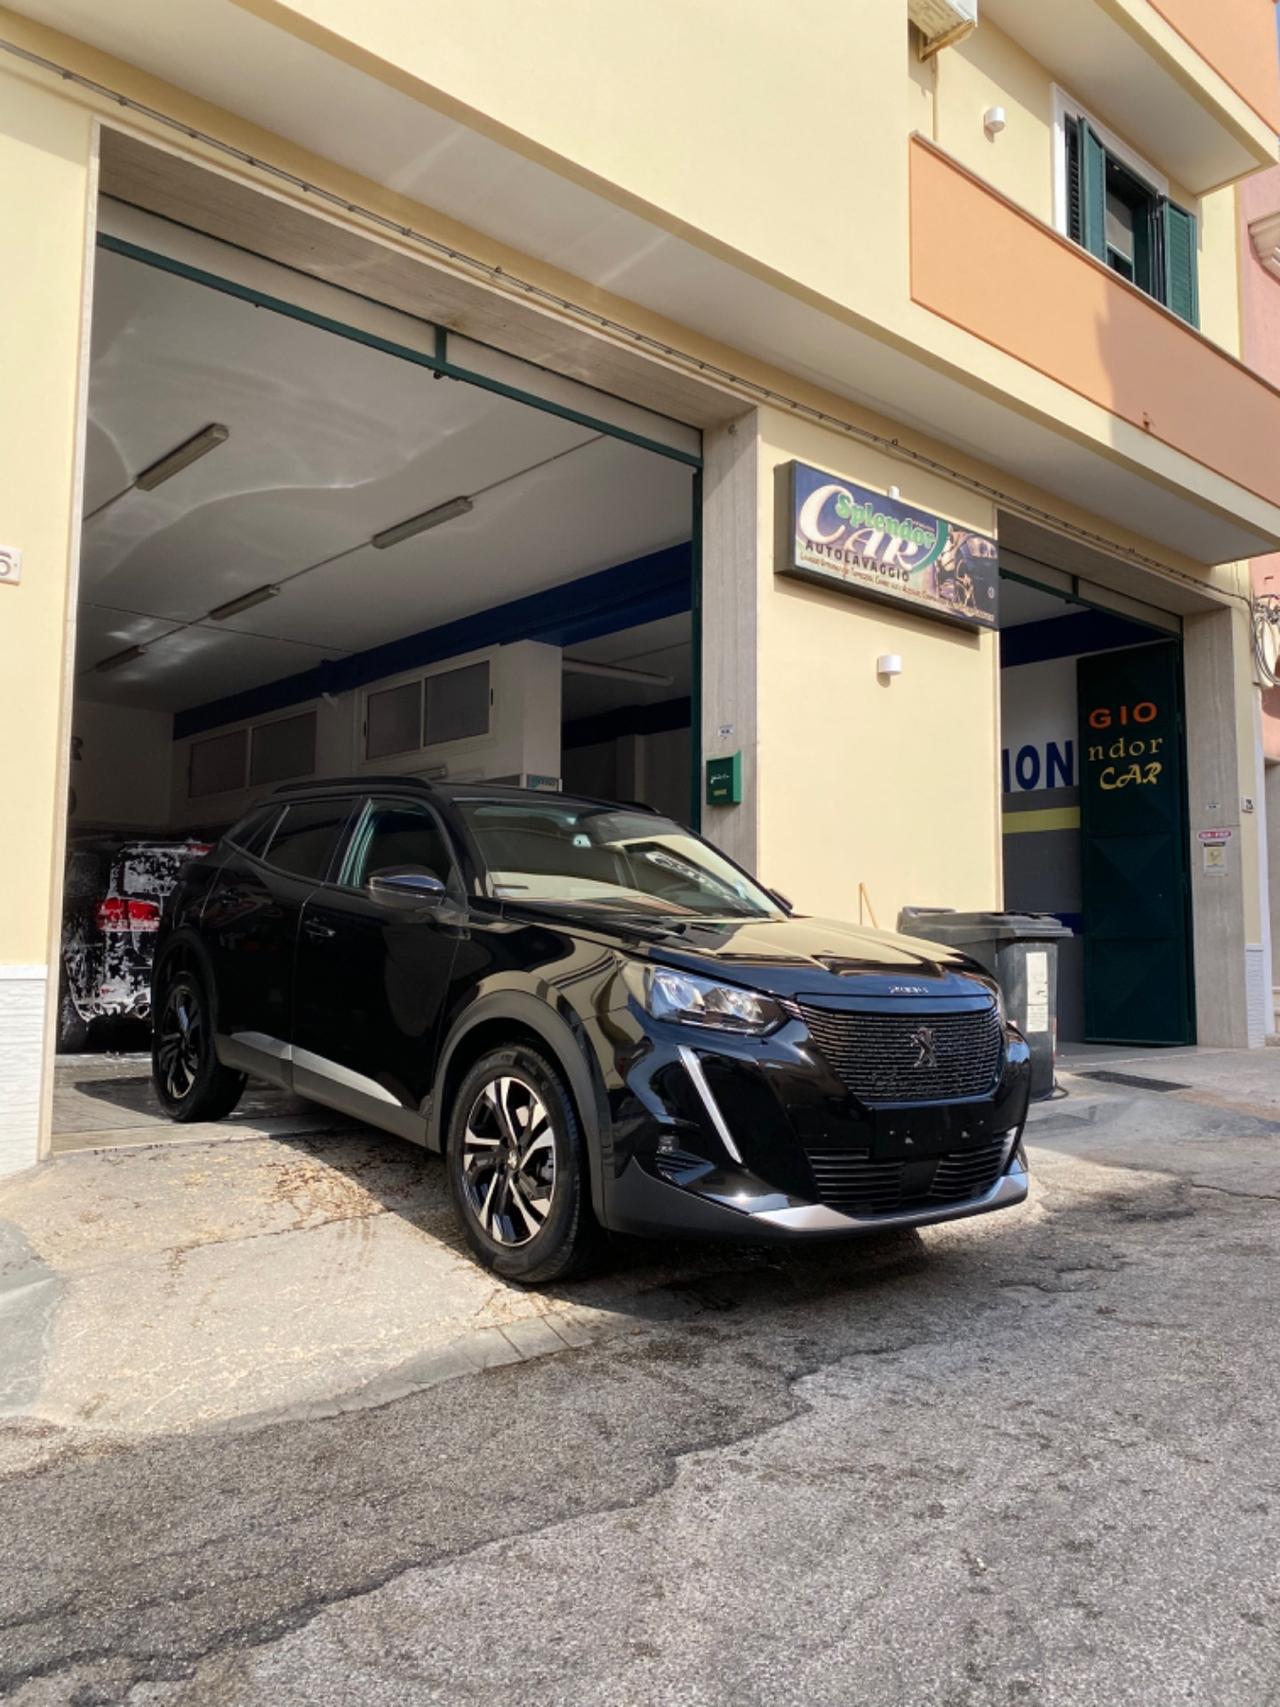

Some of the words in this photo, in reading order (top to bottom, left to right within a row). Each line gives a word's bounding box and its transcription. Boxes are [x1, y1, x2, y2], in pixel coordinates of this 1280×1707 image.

[800, 484, 919, 571] CAR
[834, 493, 936, 548] Splendor
[805, 538, 910, 582] AUTOLAVAGGIO
[1089, 702, 1157, 729] GIO
[1088, 737, 1163, 761] ndor
[1100, 761, 1162, 790] CAR
